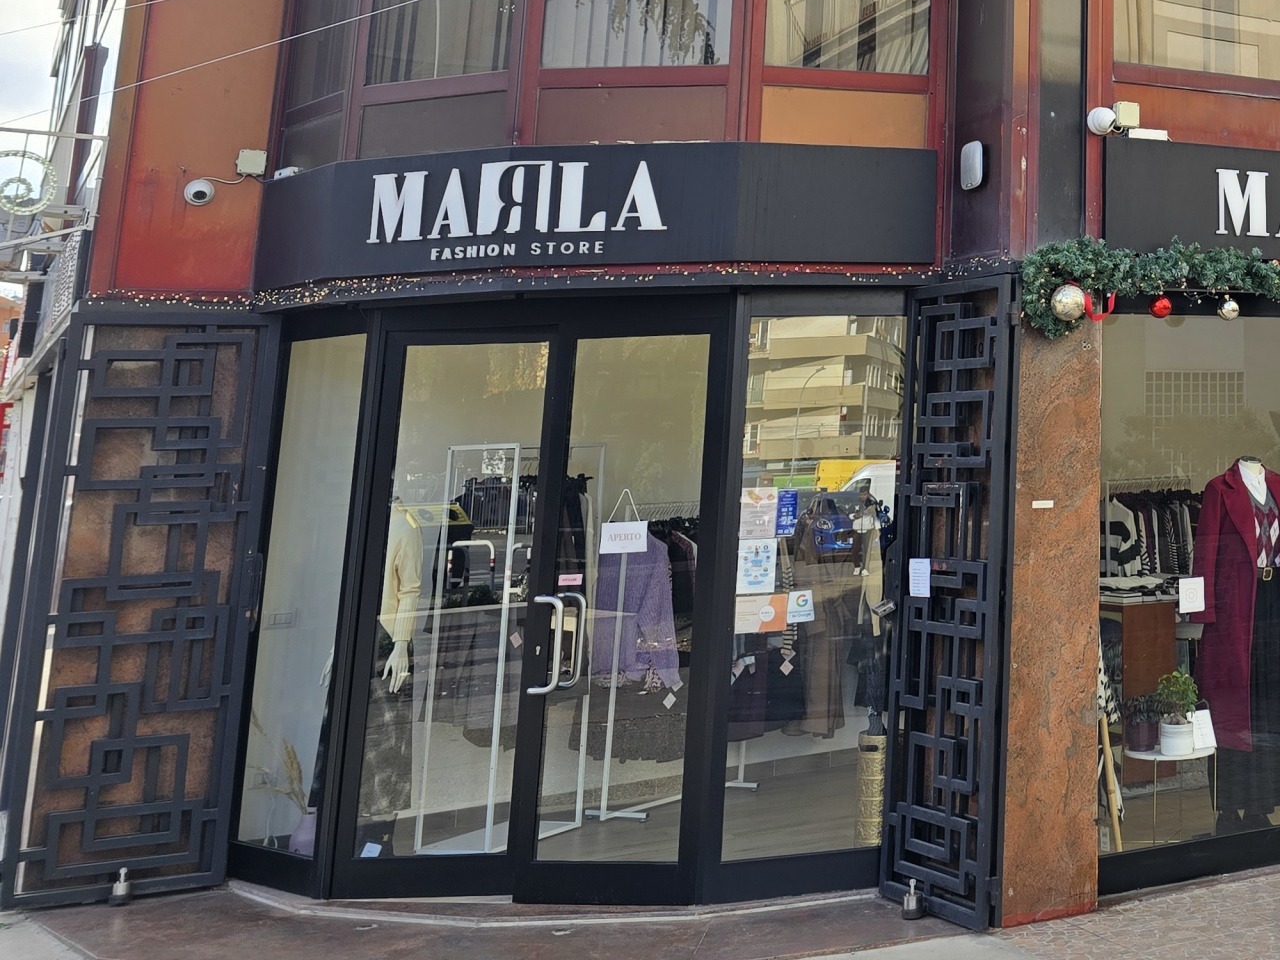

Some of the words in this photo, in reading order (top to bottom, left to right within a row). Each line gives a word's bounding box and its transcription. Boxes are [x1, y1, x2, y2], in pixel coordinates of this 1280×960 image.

[430, 243, 516, 261] FASHION
[530, 240, 605, 255] STORE
[607, 532, 642, 542] APERTO
